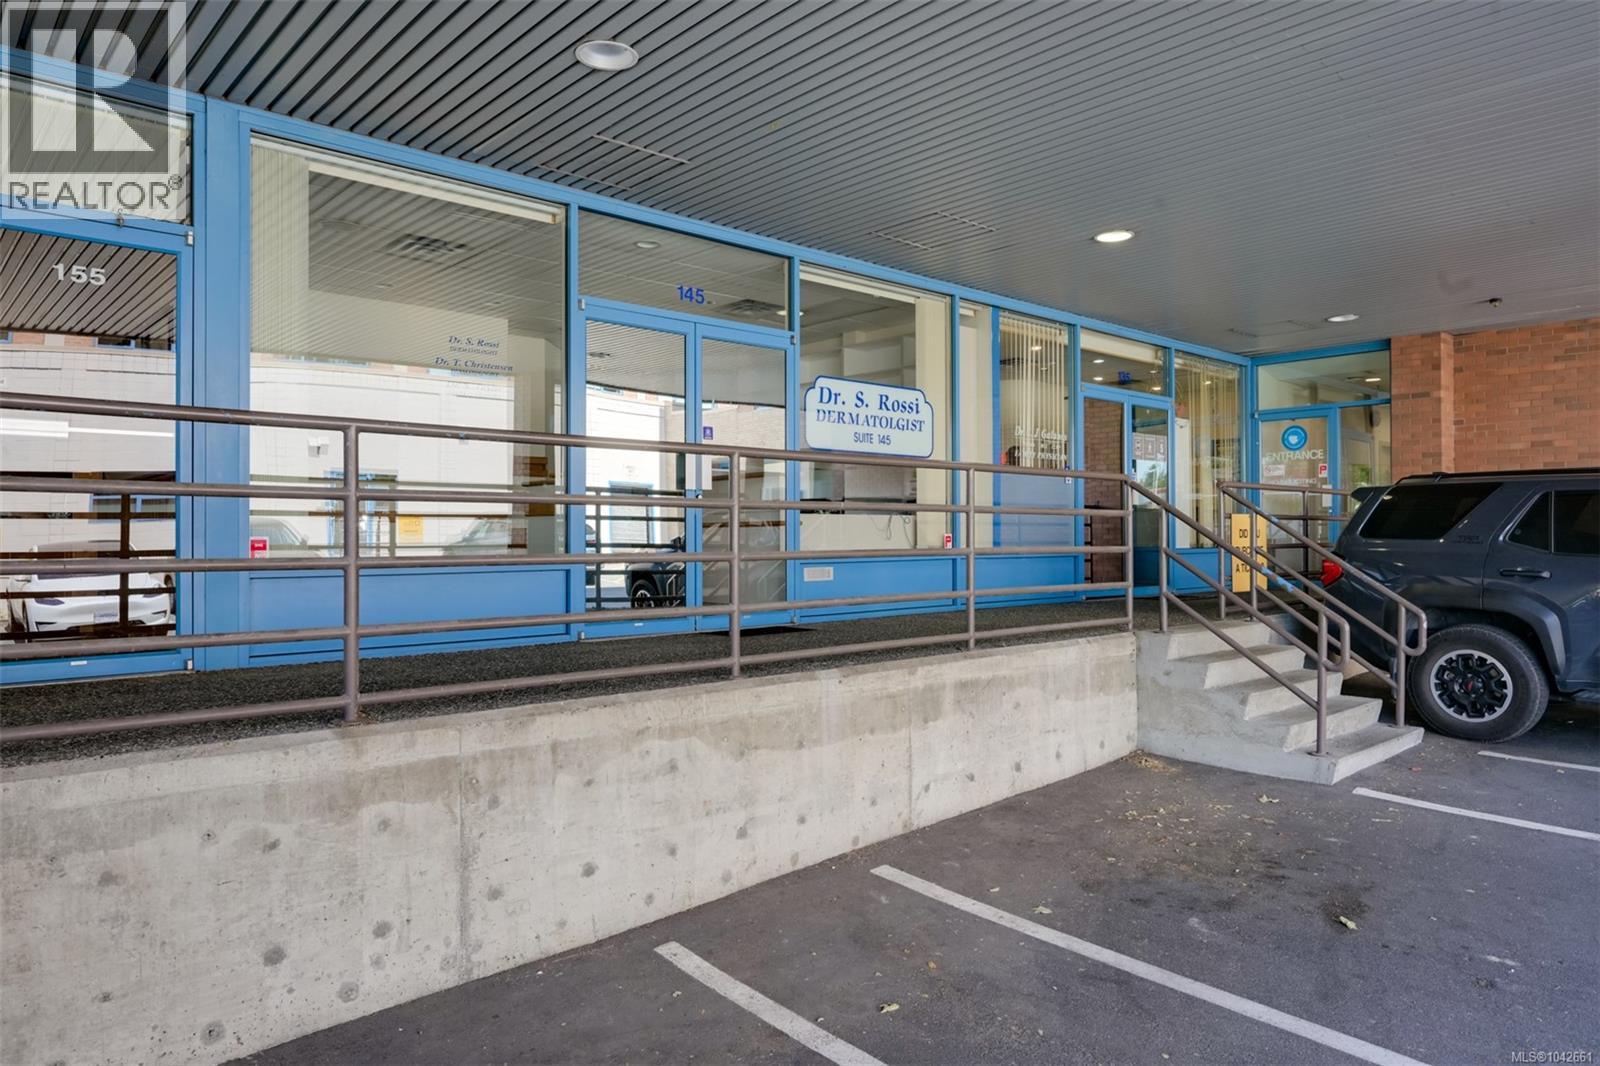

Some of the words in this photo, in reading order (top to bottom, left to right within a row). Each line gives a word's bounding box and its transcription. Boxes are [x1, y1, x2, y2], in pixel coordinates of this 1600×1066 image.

[52, 263, 106, 286] 155
[677, 285, 705, 305] 145
[448, 336, 463, 344] Dr.
[465, 337, 475, 346] S.
[477, 339, 500, 349] Rossi
[434, 356, 449, 366] Dr.
[818, 386, 846, 406] Dr.
[854, 390, 869, 409] S.
[878, 393, 921, 415] Rossi
[815, 408, 926, 432] DERMATOLGIST
[853, 431, 874, 445] SUITE
[877, 434, 892, 446] 145
[1264, 448, 1325, 462] ENTRANCE
